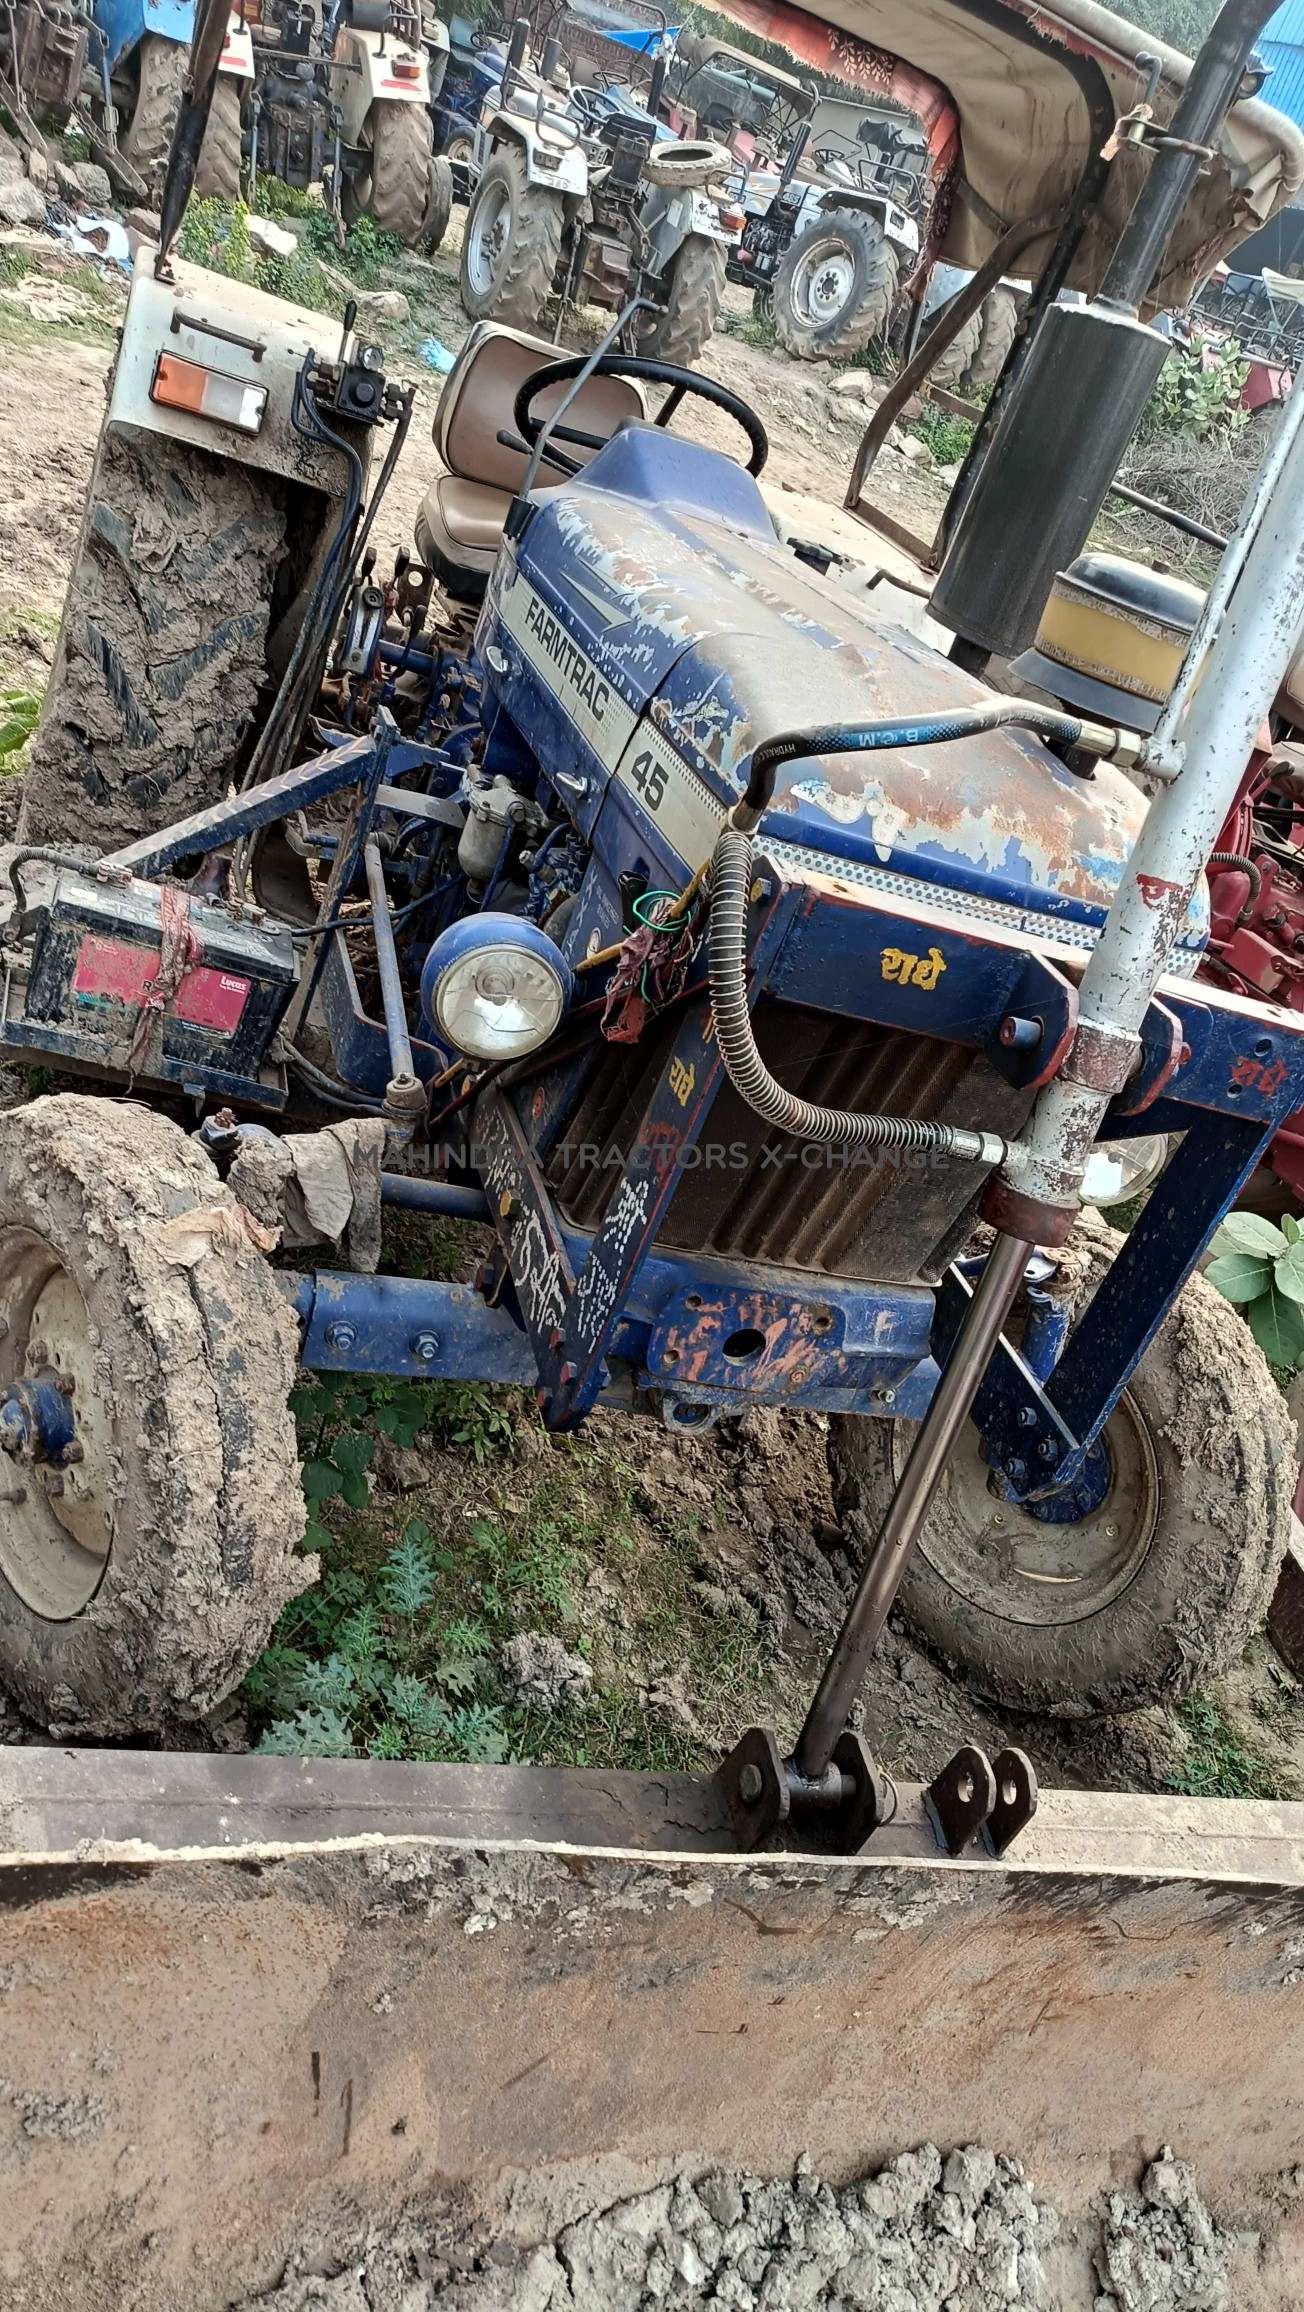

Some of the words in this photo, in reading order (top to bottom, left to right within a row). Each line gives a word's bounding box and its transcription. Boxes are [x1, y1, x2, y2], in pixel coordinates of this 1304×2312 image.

[524, 597, 610, 722] FARMTRAC
[630, 750, 670, 812] 45
[220, 975, 247, 991] Lucas
